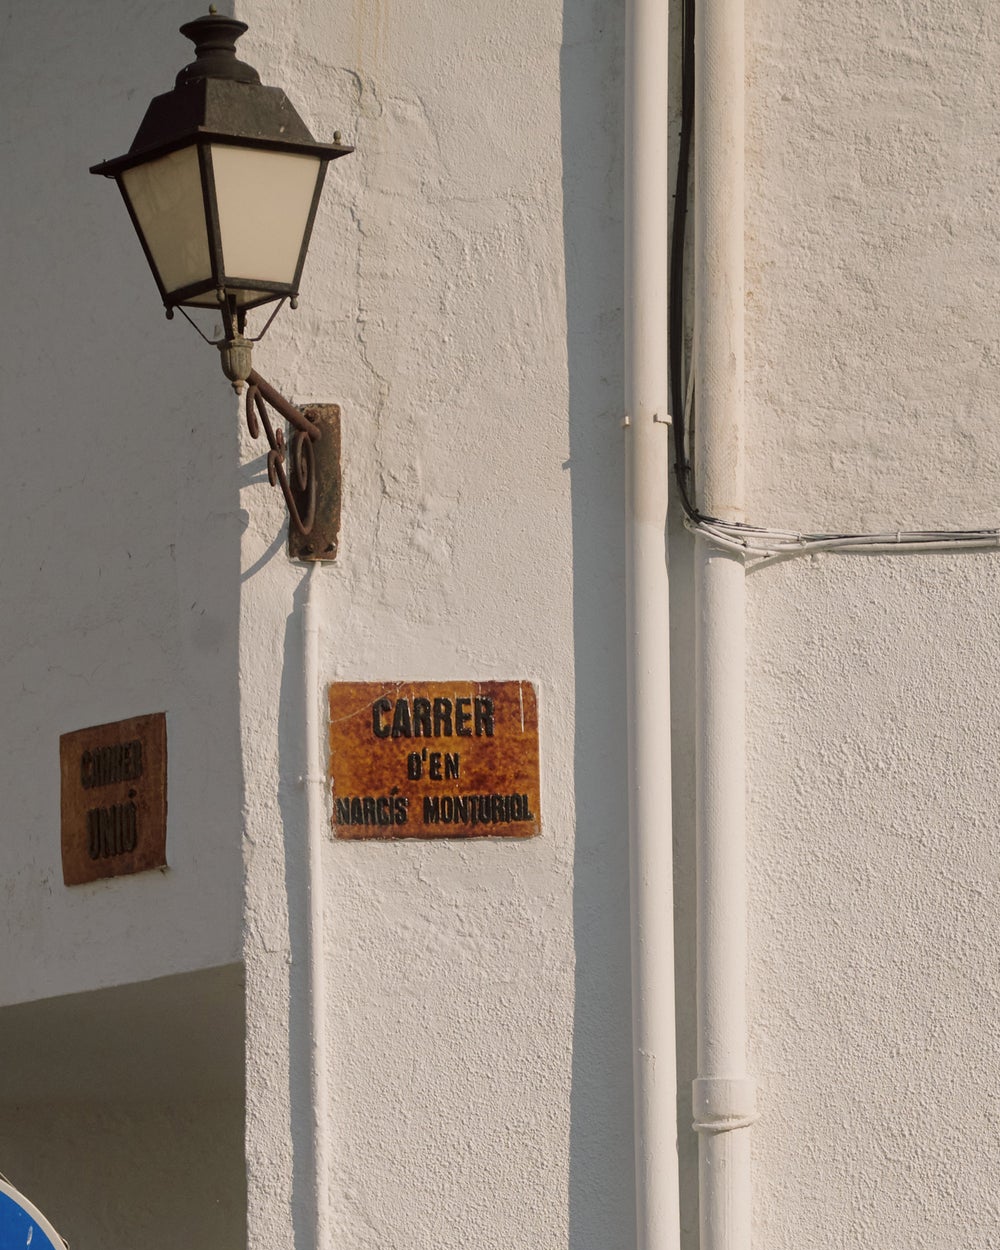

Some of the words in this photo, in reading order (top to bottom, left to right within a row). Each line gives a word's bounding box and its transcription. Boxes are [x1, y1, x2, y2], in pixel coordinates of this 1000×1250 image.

[372, 696, 495, 738] CARRER
[81, 739, 144, 790] CARRER
[407, 747, 460, 781] D'EN
[335, 786, 409, 826] NARCÍS
[423, 793, 534, 825] MONTURIOL
